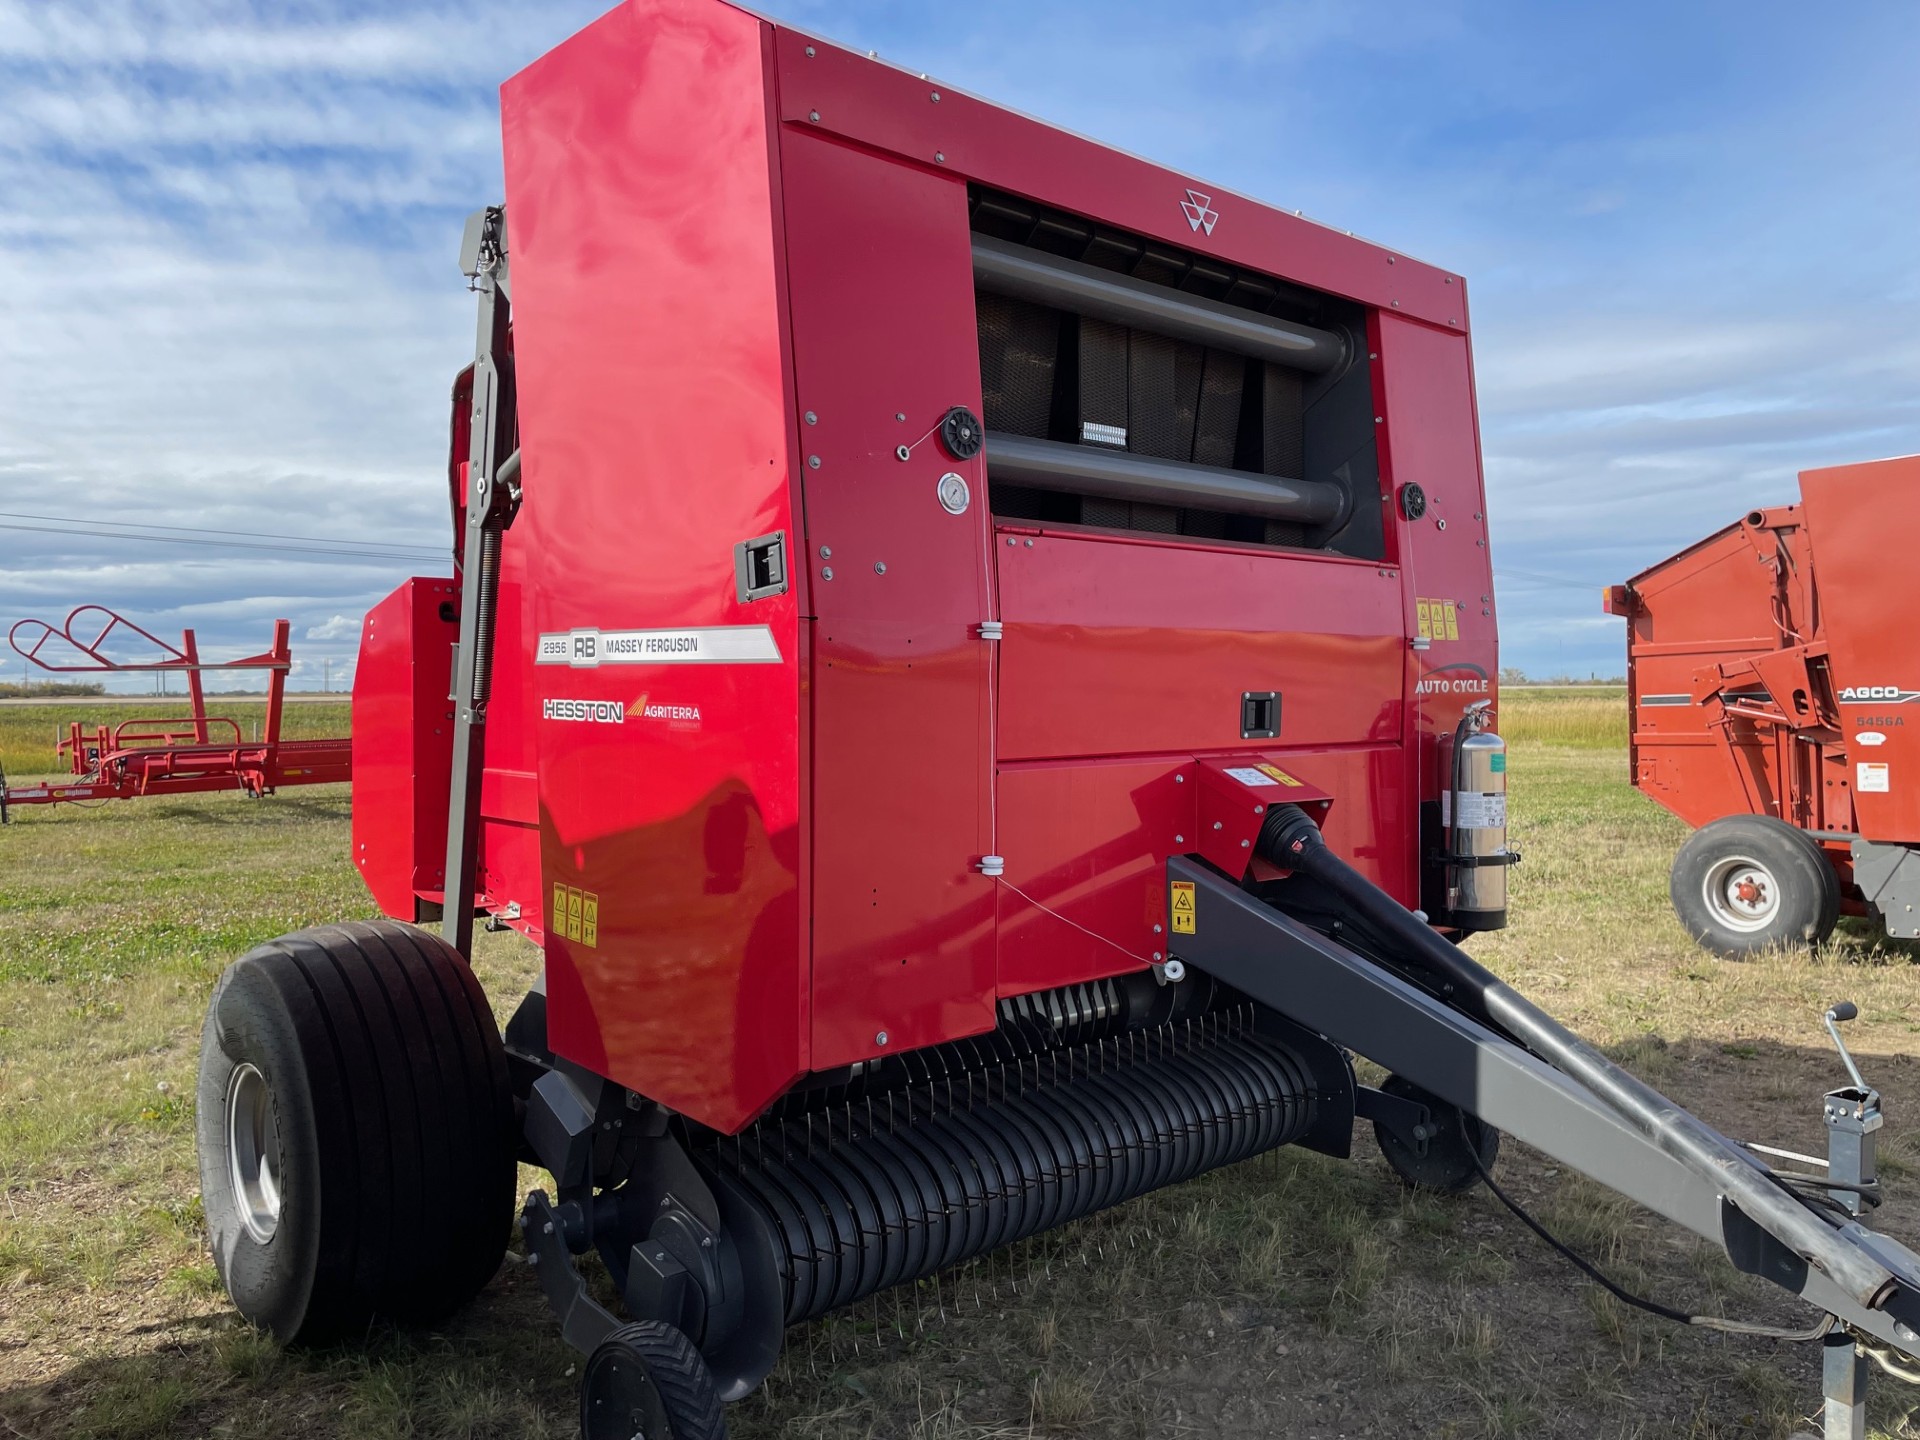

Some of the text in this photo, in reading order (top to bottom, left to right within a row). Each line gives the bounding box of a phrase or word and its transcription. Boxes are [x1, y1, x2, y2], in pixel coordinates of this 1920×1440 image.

[543, 636, 698, 658] 2956 RB MASSEY FERGUSON
[1415, 680, 1488, 694] AUTO CYCLE
[1842, 686, 1899, 699] AGCO
[543, 699, 624, 723] HESSTON
[644, 705, 701, 720] AGRITERRA
[1856, 716, 1904, 727] 5456A
